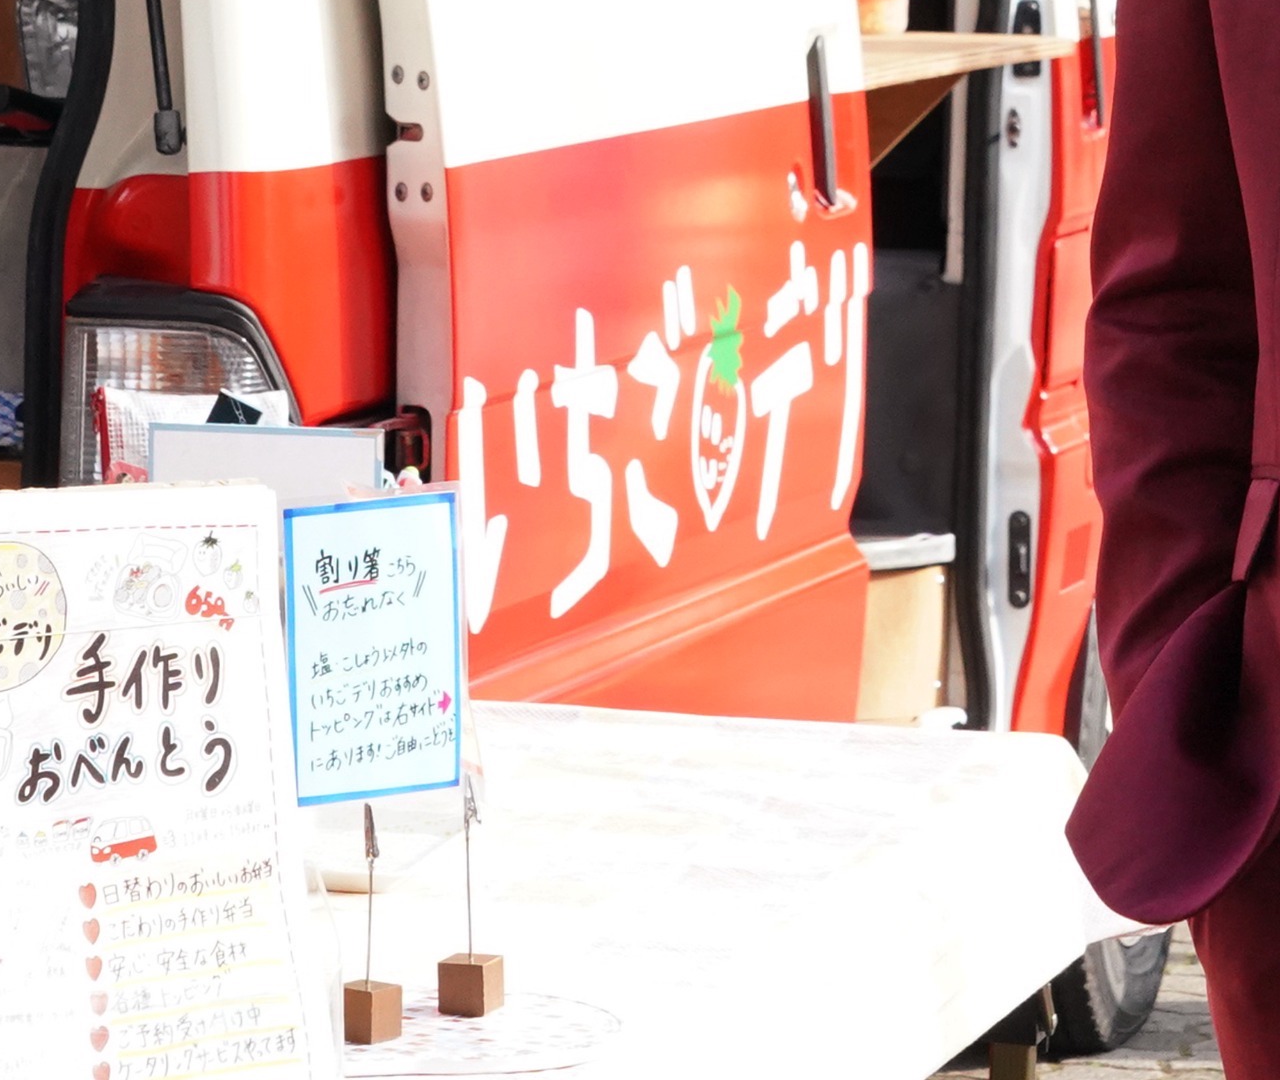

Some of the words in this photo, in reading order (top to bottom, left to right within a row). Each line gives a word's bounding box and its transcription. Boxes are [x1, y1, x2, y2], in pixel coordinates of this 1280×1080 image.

[322, 590, 406, 622] お忘れなく
[66, 631, 221, 725] 手作り
[311, 673, 428, 710] いちごデリおすすめ
[310, 689, 441, 742] トッピングは右サイド
[19, 719, 234, 804] おべんとう
[103, 858, 273, 905] 日替わりのおいしいお弁当
[107, 897, 255, 941] こだわりの手作り弁当
